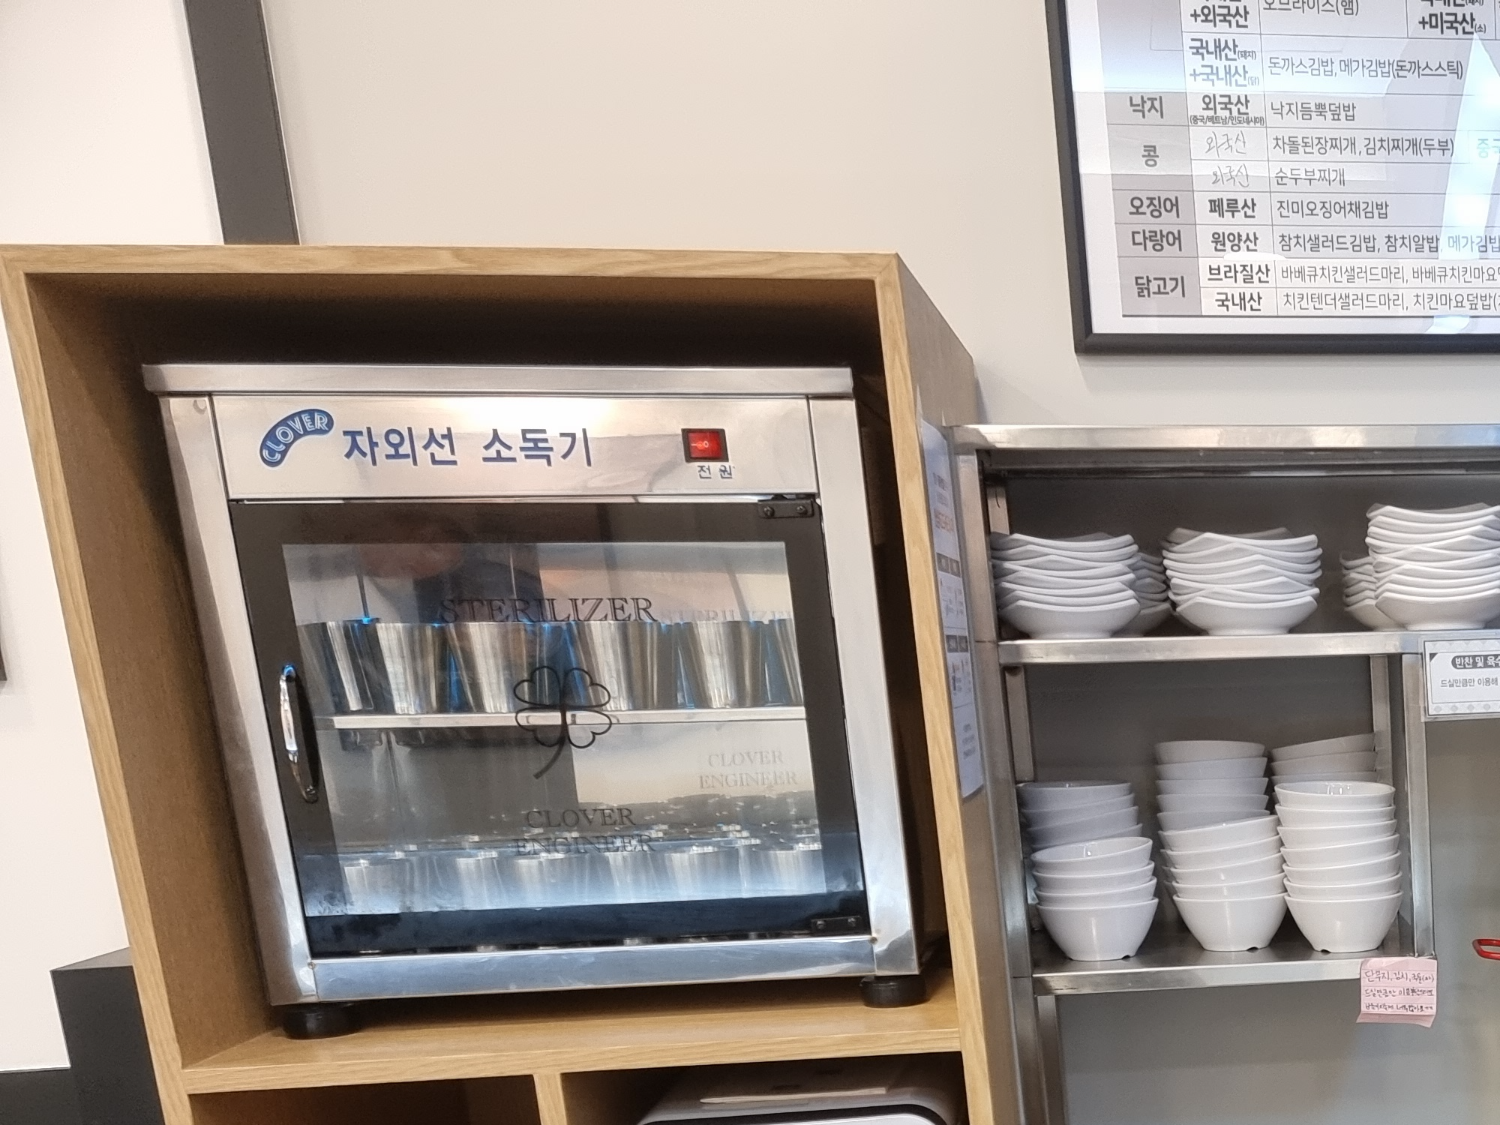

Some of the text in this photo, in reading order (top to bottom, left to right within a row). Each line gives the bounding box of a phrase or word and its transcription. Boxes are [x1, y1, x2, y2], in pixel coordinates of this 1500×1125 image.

[1190, 5, 1249, 29] +외국산
[1268, 57, 1464, 80] 돈까스김밥, 메가김밥(돈까스스틱)
[1129, 95, 1164, 119] 낙지
[1202, 93, 1250, 116] 외국산
[1271, 102, 1357, 121] 낙지듬뿍덮밥
[1141, 145, 1160, 168] 콩
[1363, 136, 1454, 158] 김치찌개(두부)
[1274, 168, 1346, 187] 순두부찌개
[1128, 196, 1180, 218] 오징어
[1208, 198, 1257, 219] 페루산
[1276, 199, 1389, 220] 진미오징어채김밥
[1131, 229, 1183, 252] 다랑어
[1211, 231, 1259, 252] 원양산
[1278, 233, 1380, 254] 참치샐러드김밥,
[1207, 263, 1271, 284] 브라질산
[1134, 275, 1186, 298] 닭고기
[1215, 291, 1263, 312] 국내산
[262, 411, 329, 464] CLOVER
[342, 426, 592, 467] 자외선 소독기
[440, 597, 659, 623] STERILIZER
[1455, 656, 1473, 668] 반찬
[1475, 655, 1484, 668] 및
[1440, 678, 1475, 688] 드실만큼만
[1477, 677, 1498, 687] 이용해
[525, 807, 637, 829] CLOVER
[515, 833, 657, 856] ENGINEER
